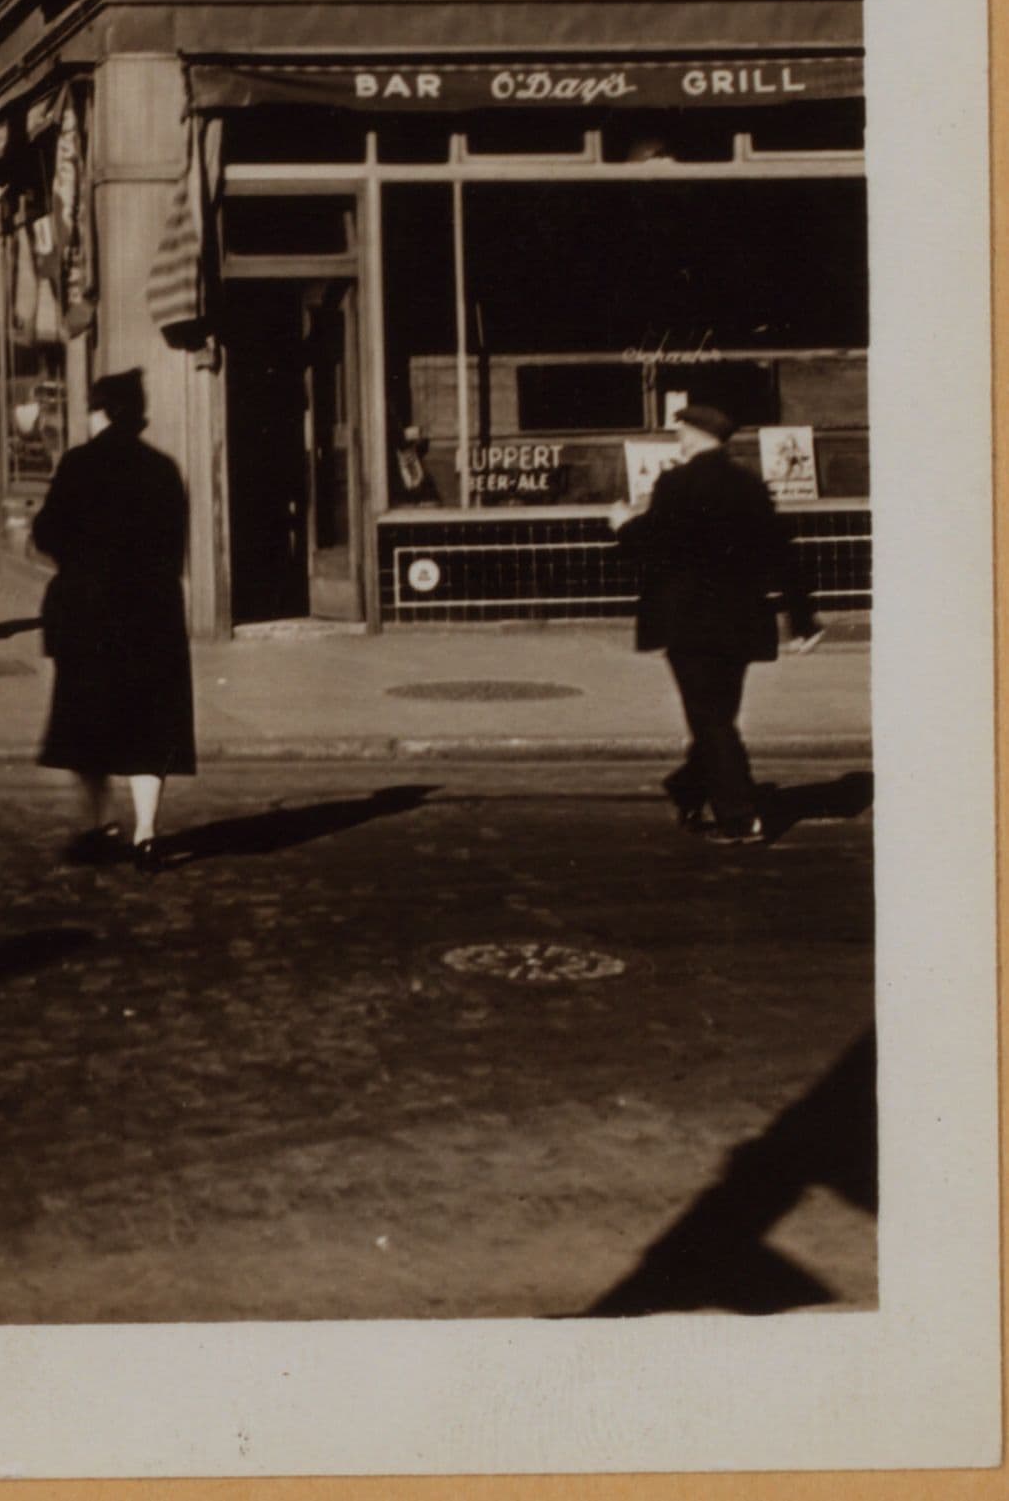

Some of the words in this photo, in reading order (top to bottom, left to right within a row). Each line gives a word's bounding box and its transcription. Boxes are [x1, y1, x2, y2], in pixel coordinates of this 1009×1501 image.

[355, 73, 442, 99] BAR
[491, 70, 637, 104] O'Day's
[681, 66, 807, 94] GRILL
